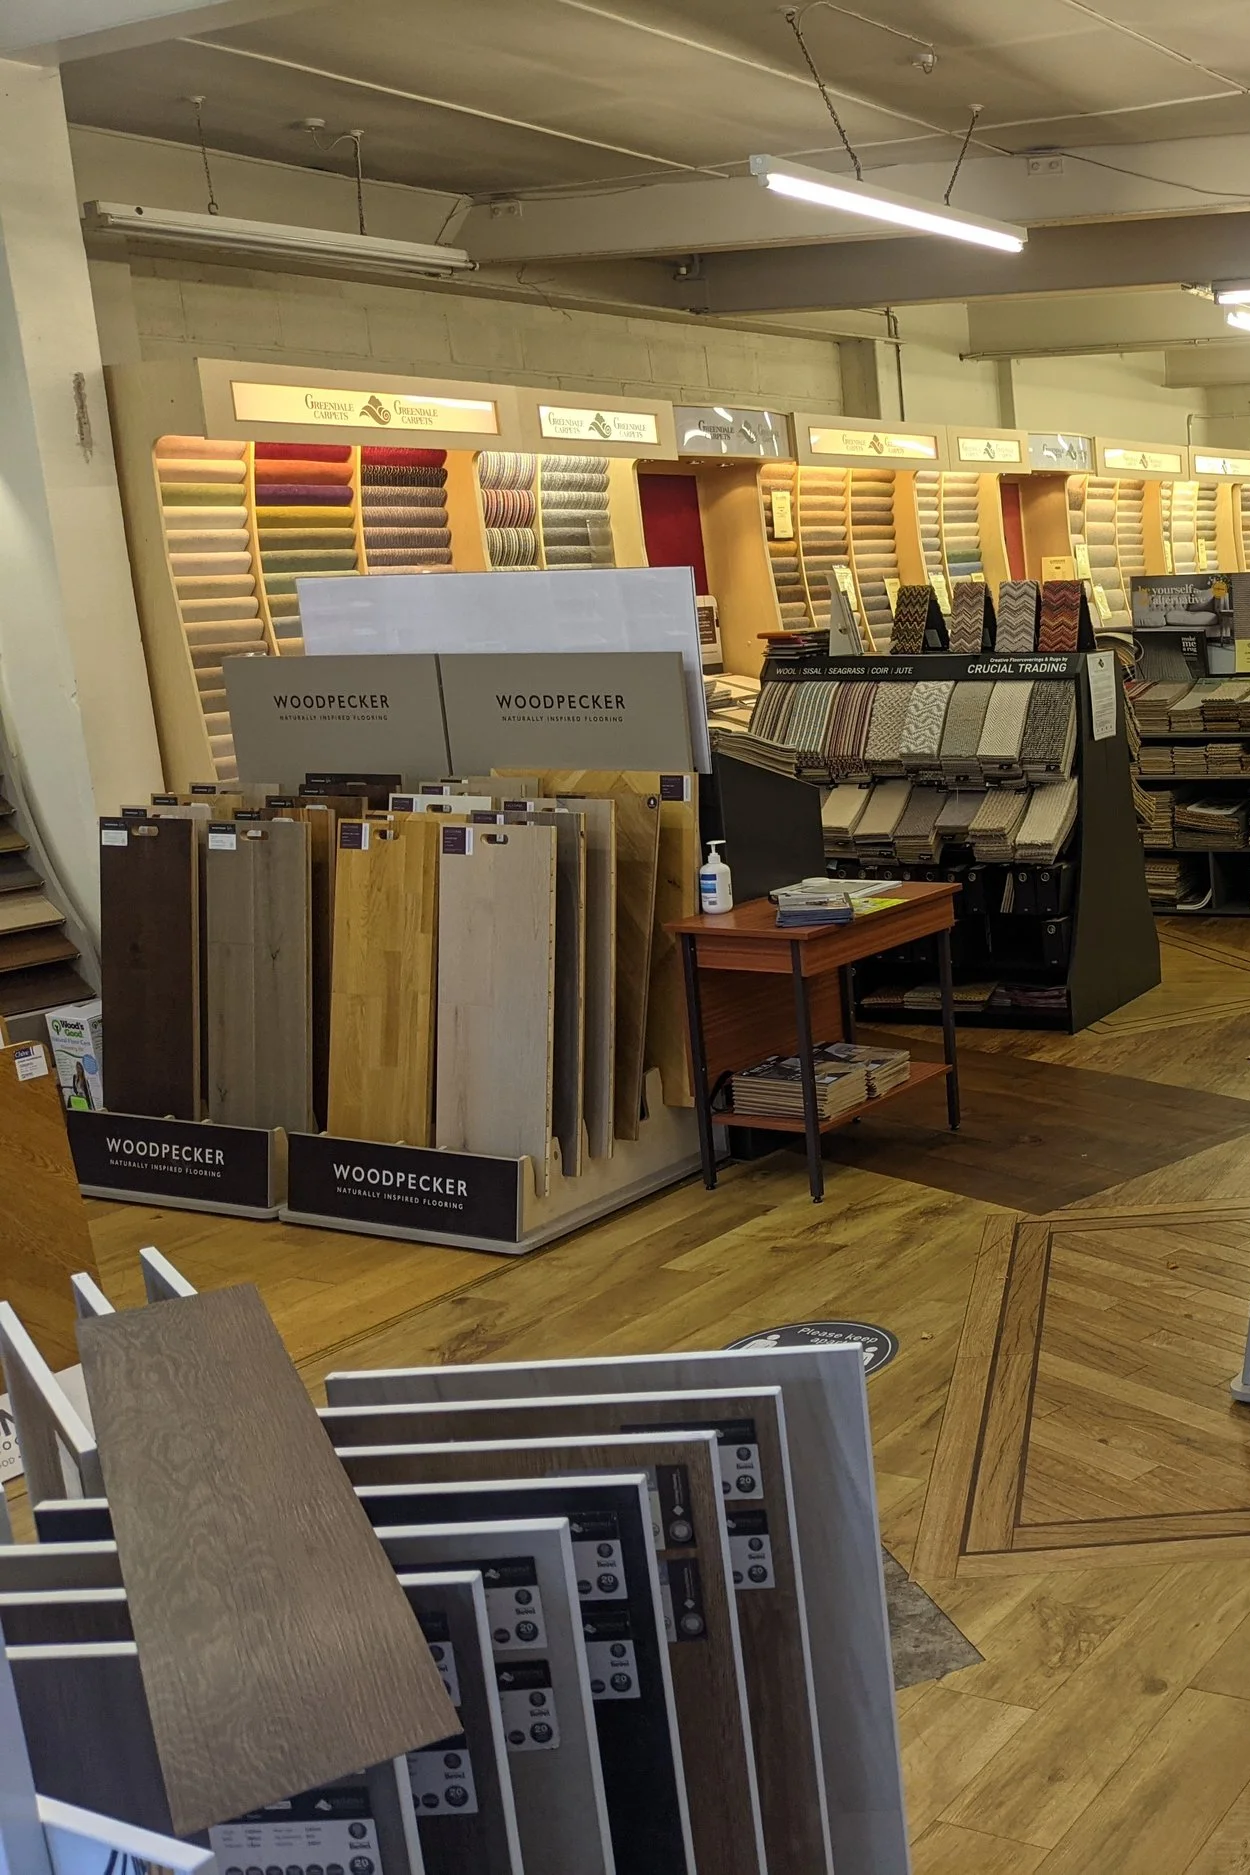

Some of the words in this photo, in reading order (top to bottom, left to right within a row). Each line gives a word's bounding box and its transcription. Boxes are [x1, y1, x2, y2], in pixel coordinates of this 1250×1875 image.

[305, 394, 354, 412] GREENDALE
[394, 400, 438, 417] GREENDALE
[314, 410, 349, 420] CARPETS
[401, 416, 433, 425] CARPETS
[548, 412, 584, 427] GREENDALE
[613, 417, 647, 432] GREENDALE
[698, 420, 734, 433] GREENDALE
[1152, 583, 1194, 597] yourself
[1152, 594, 1207, 605] alternative
[776, 667, 796, 675] WOOL
[803, 667, 822, 675] SISAL
[828, 667, 865, 675] SEAGRASS
[871, 667, 889, 675] COIR
[894, 667, 914, 675] JUTE
[967, 664, 1015, 674] CRUCIAL
[1018, 663, 1067, 673] TRADING
[273, 695, 389, 709] WOODPECKER
[496, 695, 625, 709] WOODPECKER
[60, 1020, 85, 1031] Wood's
[65, 1028, 84, 1039] Good
[106, 1137, 225, 1165] WOODPECKER
[110, 1159, 148, 1169] NATURALLY
[151, 1163, 182, 1173] INSPIRED
[185, 1168, 221, 1178] FLOORING
[333, 1163, 468, 1197] WOODPECKER
[337, 1186, 380, 1198] NATURALLY
[384, 1193, 419, 1204] INSPIRED
[423, 1199, 464, 1210] FLOORING
[797, 1327, 844, 1339] Please
[845, 1333, 879, 1344] keep
[739, 1477, 751, 1485] 20
[751, 1566, 763, 1575] 20
[601, 1575, 614, 1584] 20
[519, 1623, 533, 1632] 20
[614, 1674, 627, 1683] 20
[534, 1725, 548, 1733] 20
[354, 1858, 369, 1867] 20
